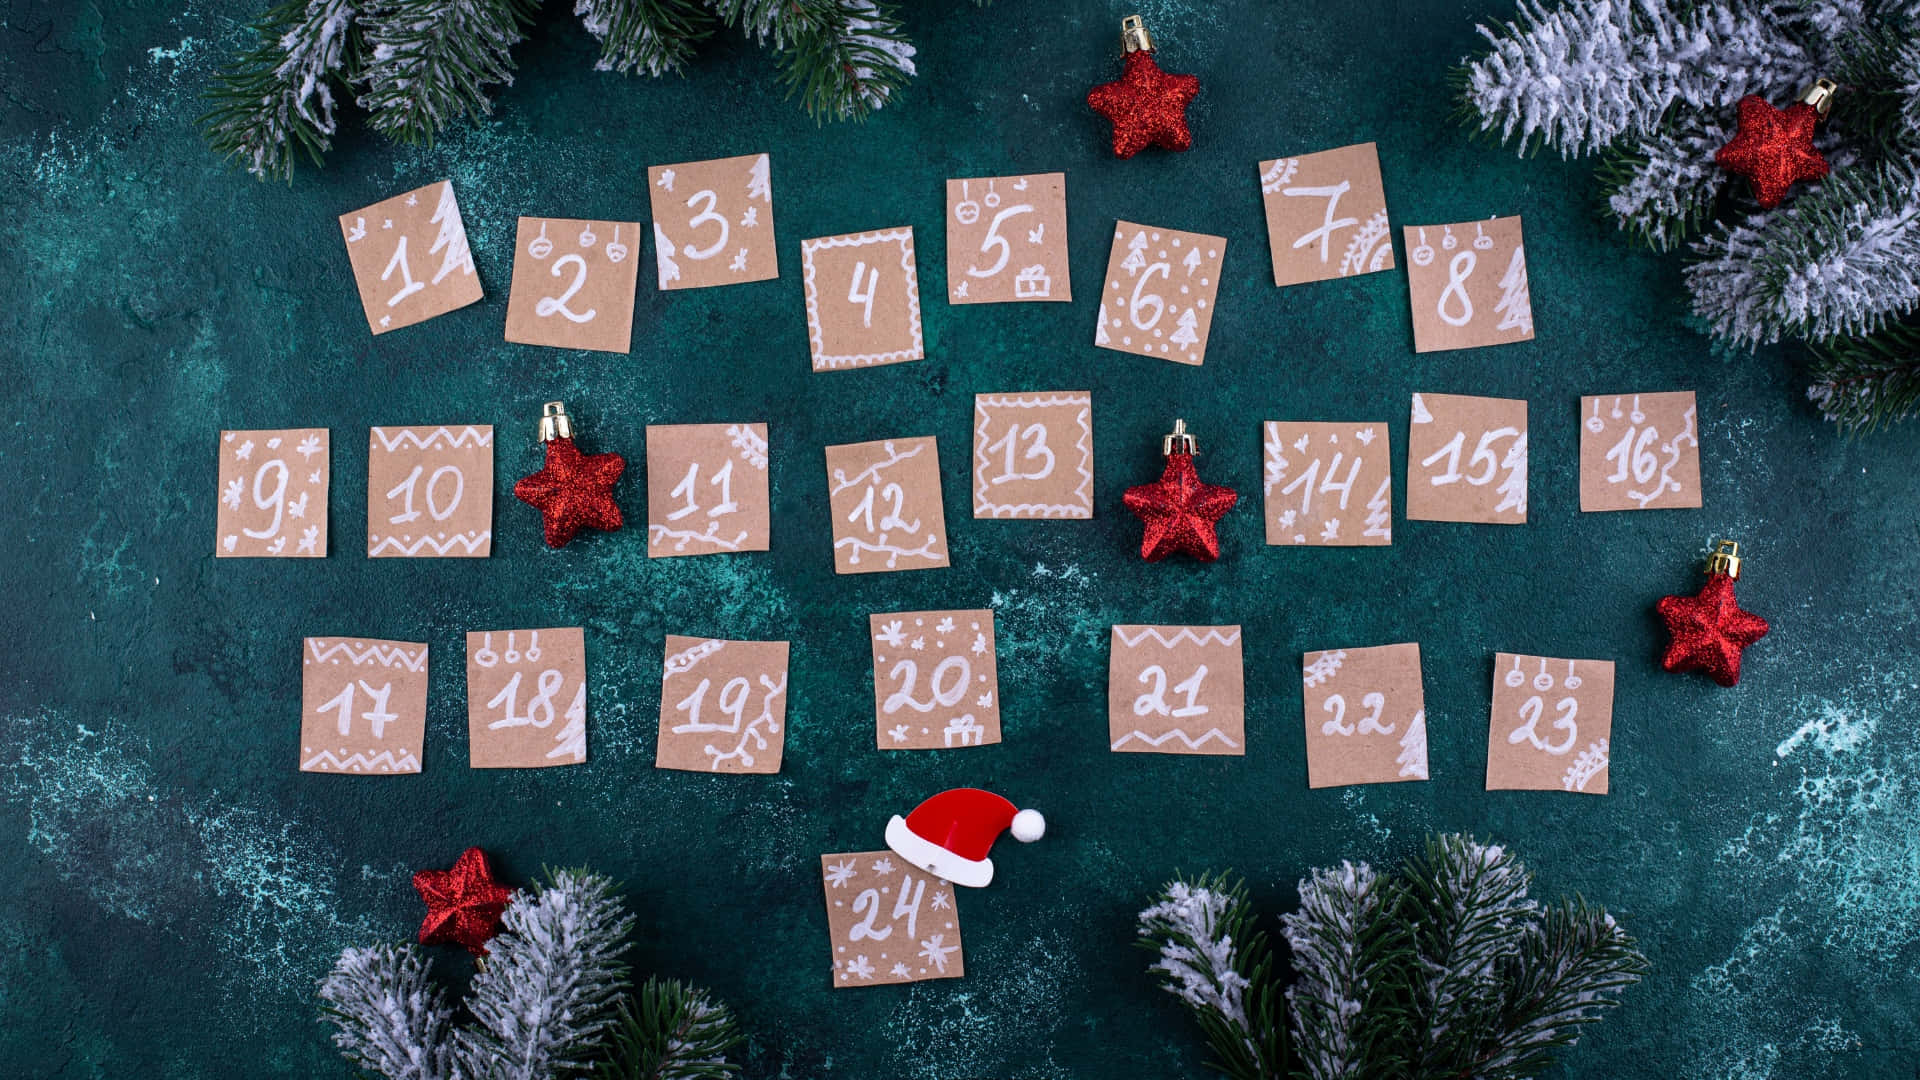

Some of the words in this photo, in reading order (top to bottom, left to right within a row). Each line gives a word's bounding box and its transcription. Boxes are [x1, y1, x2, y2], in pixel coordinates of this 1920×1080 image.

[683, 189, 730, 260] 3
[966, 203, 1035, 279] 5
[1282, 180, 1358, 263] 7
[381, 235, 425, 308] 1
[535, 253, 597, 324] 2
[847, 261, 880, 328] 4
[1129, 261, 1171, 331] 6
[1436, 250, 1477, 327] 8
[988, 422, 1056, 485] 13
[1281, 451, 1361, 515] 14
[1421, 426, 1519, 487] 15
[1605, 425, 1659, 484] 16
[242, 458, 290, 540] 9
[386, 465, 464, 525] 10
[666, 458, 738, 521] 11
[847, 482, 921, 534] 12
[316, 679, 399, 739] 17
[487, 669, 564, 731] 18
[671, 676, 751, 734] 19
[882, 655, 971, 714] 20
[1133, 664, 1209, 718] 21
[1321, 692, 1396, 737] 22
[1508, 695, 1578, 755] 23
[849, 874, 926, 941] 24
